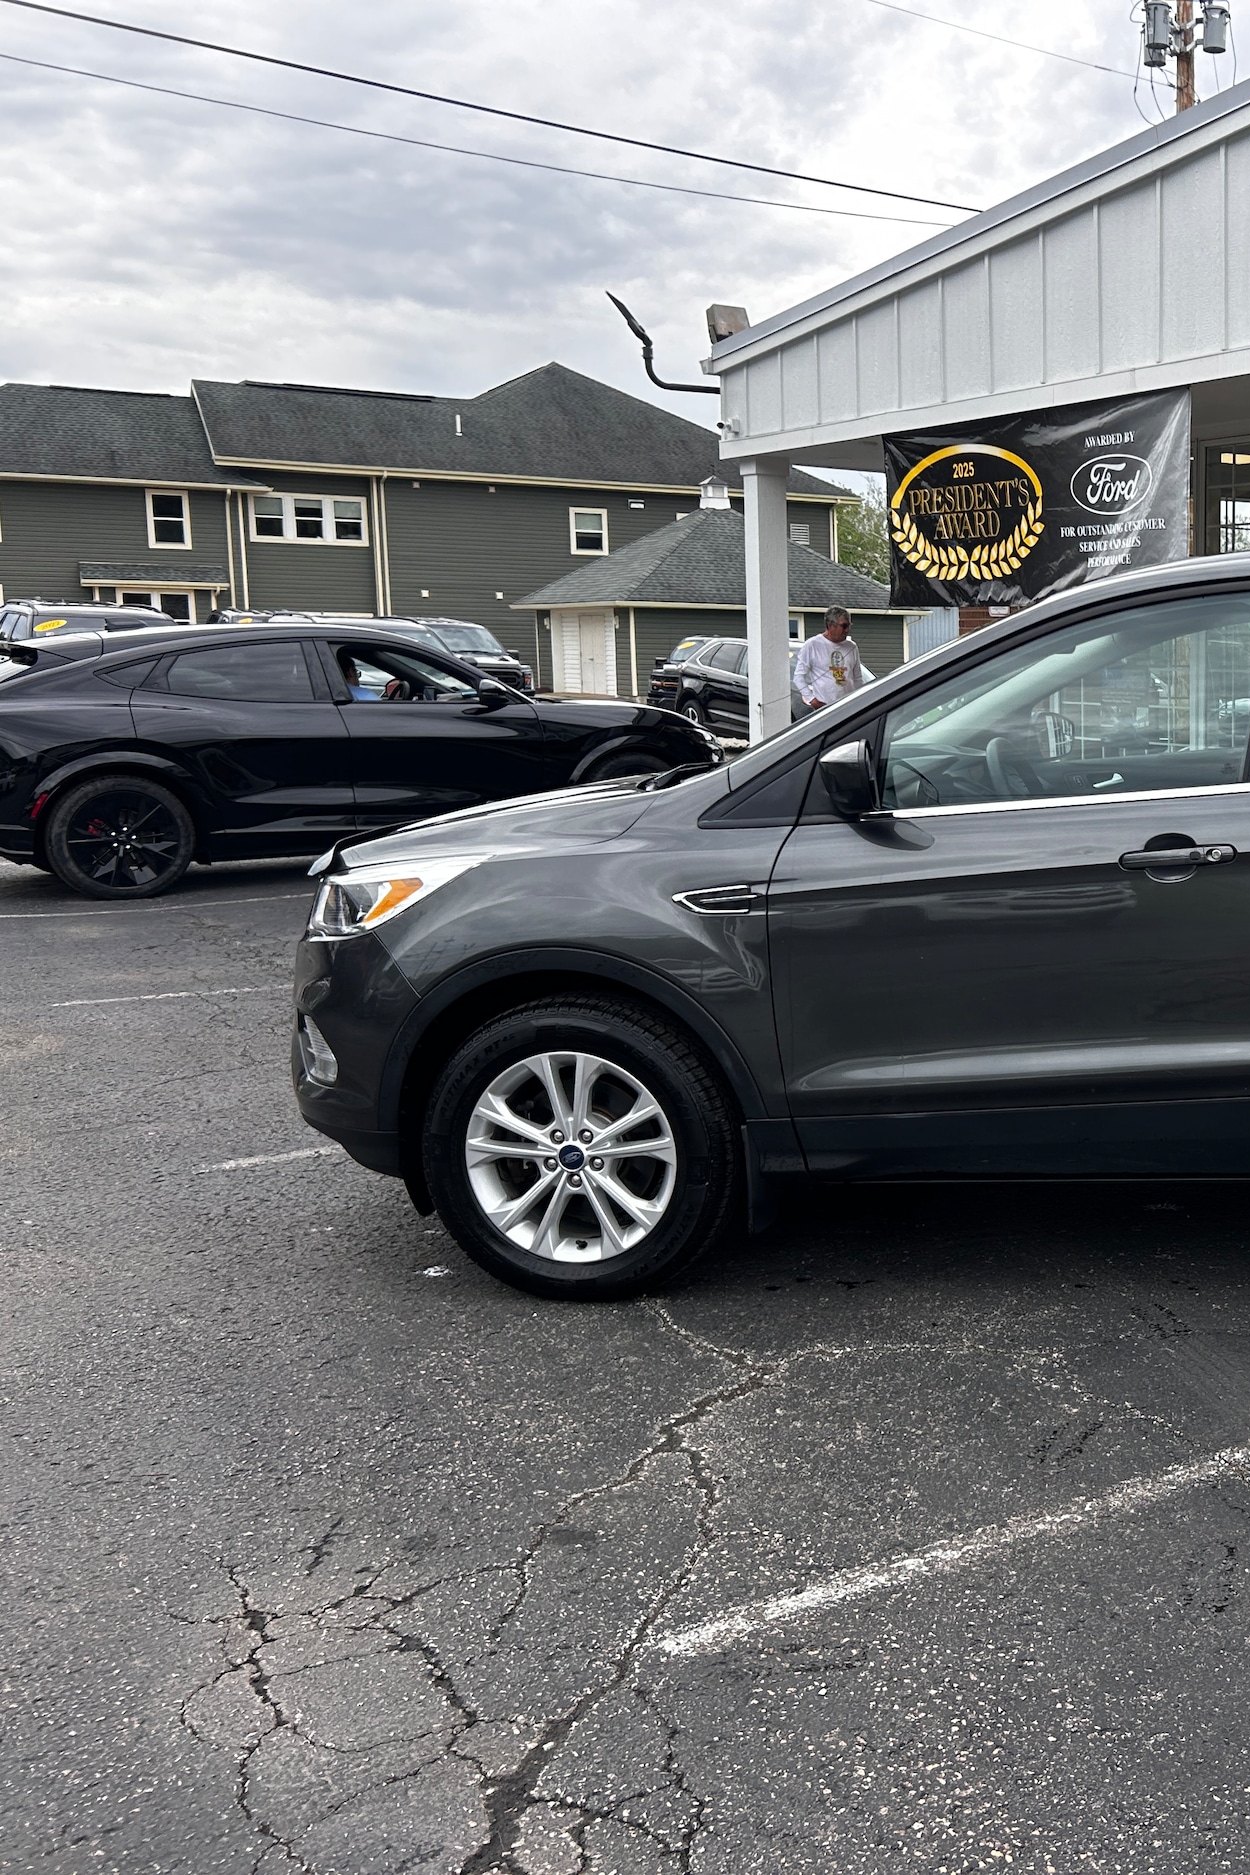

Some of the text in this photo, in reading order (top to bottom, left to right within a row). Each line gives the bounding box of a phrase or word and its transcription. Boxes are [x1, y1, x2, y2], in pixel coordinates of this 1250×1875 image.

[1084, 430, 1136, 448] AWARDED BY
[952, 461, 975, 479] 2025
[1086, 462, 1141, 504] Ford
[908, 477, 1030, 516] PRESIDENT'S
[933, 510, 1000, 540] AWARD
[1060, 526, 1076, 538] FOR
[1124, 518, 1166, 532] CUSOMER
[1079, 540, 1109, 553] SERVICE
